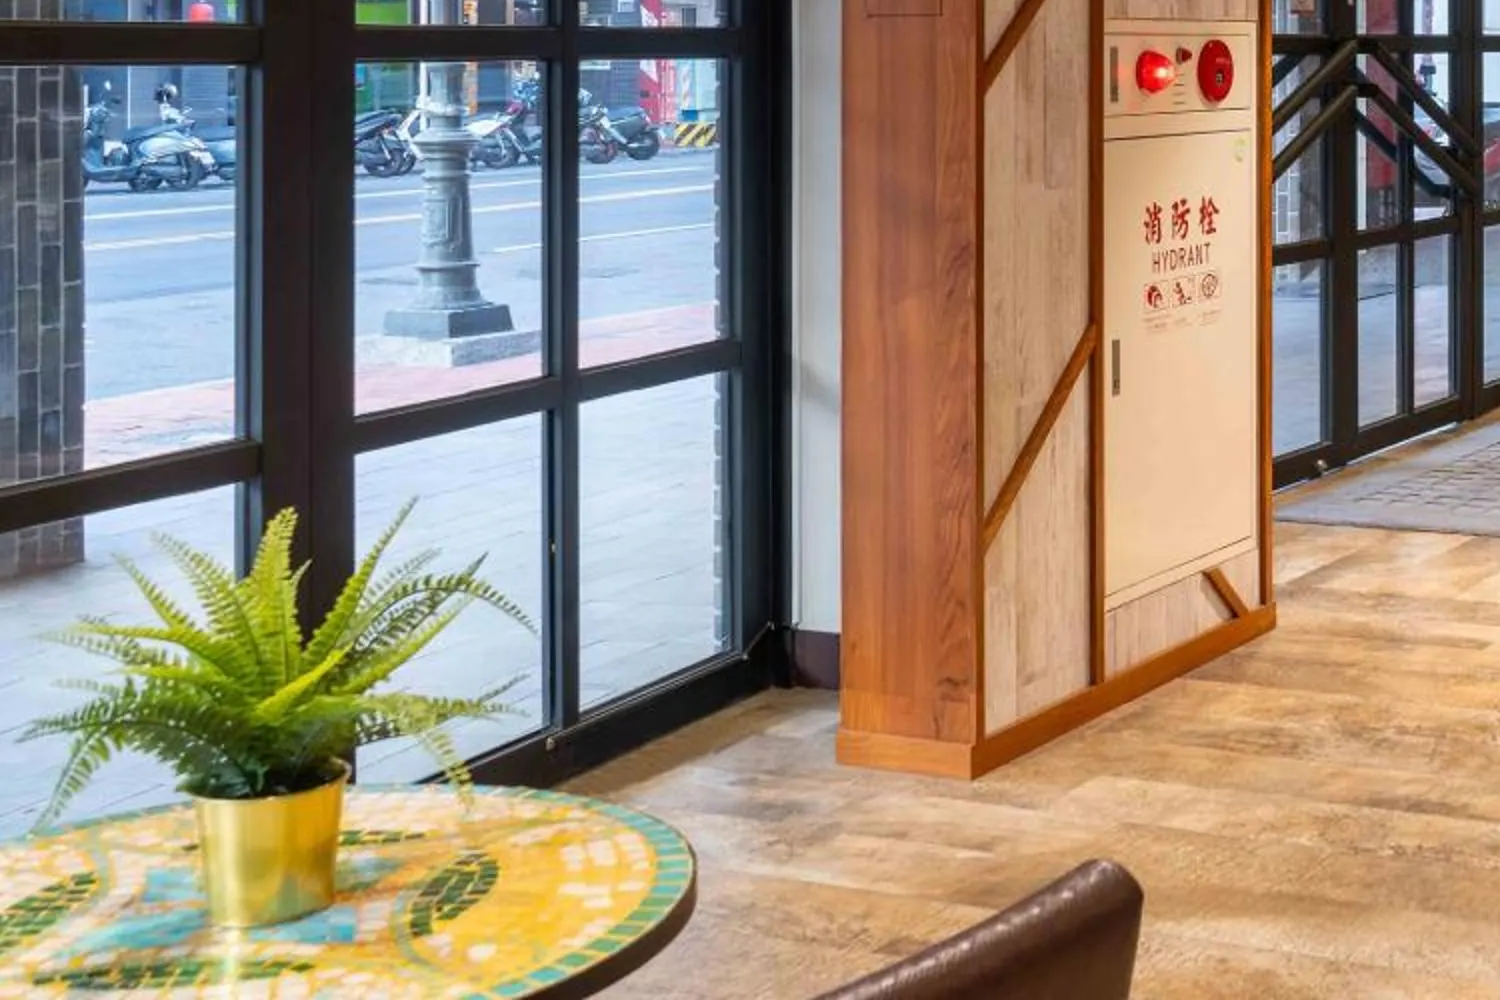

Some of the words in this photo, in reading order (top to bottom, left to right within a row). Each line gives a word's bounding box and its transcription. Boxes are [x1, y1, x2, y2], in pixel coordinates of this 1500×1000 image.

[1144, 196, 1220, 244] 消防栓
[1151, 242, 1211, 273] HYDRANT
